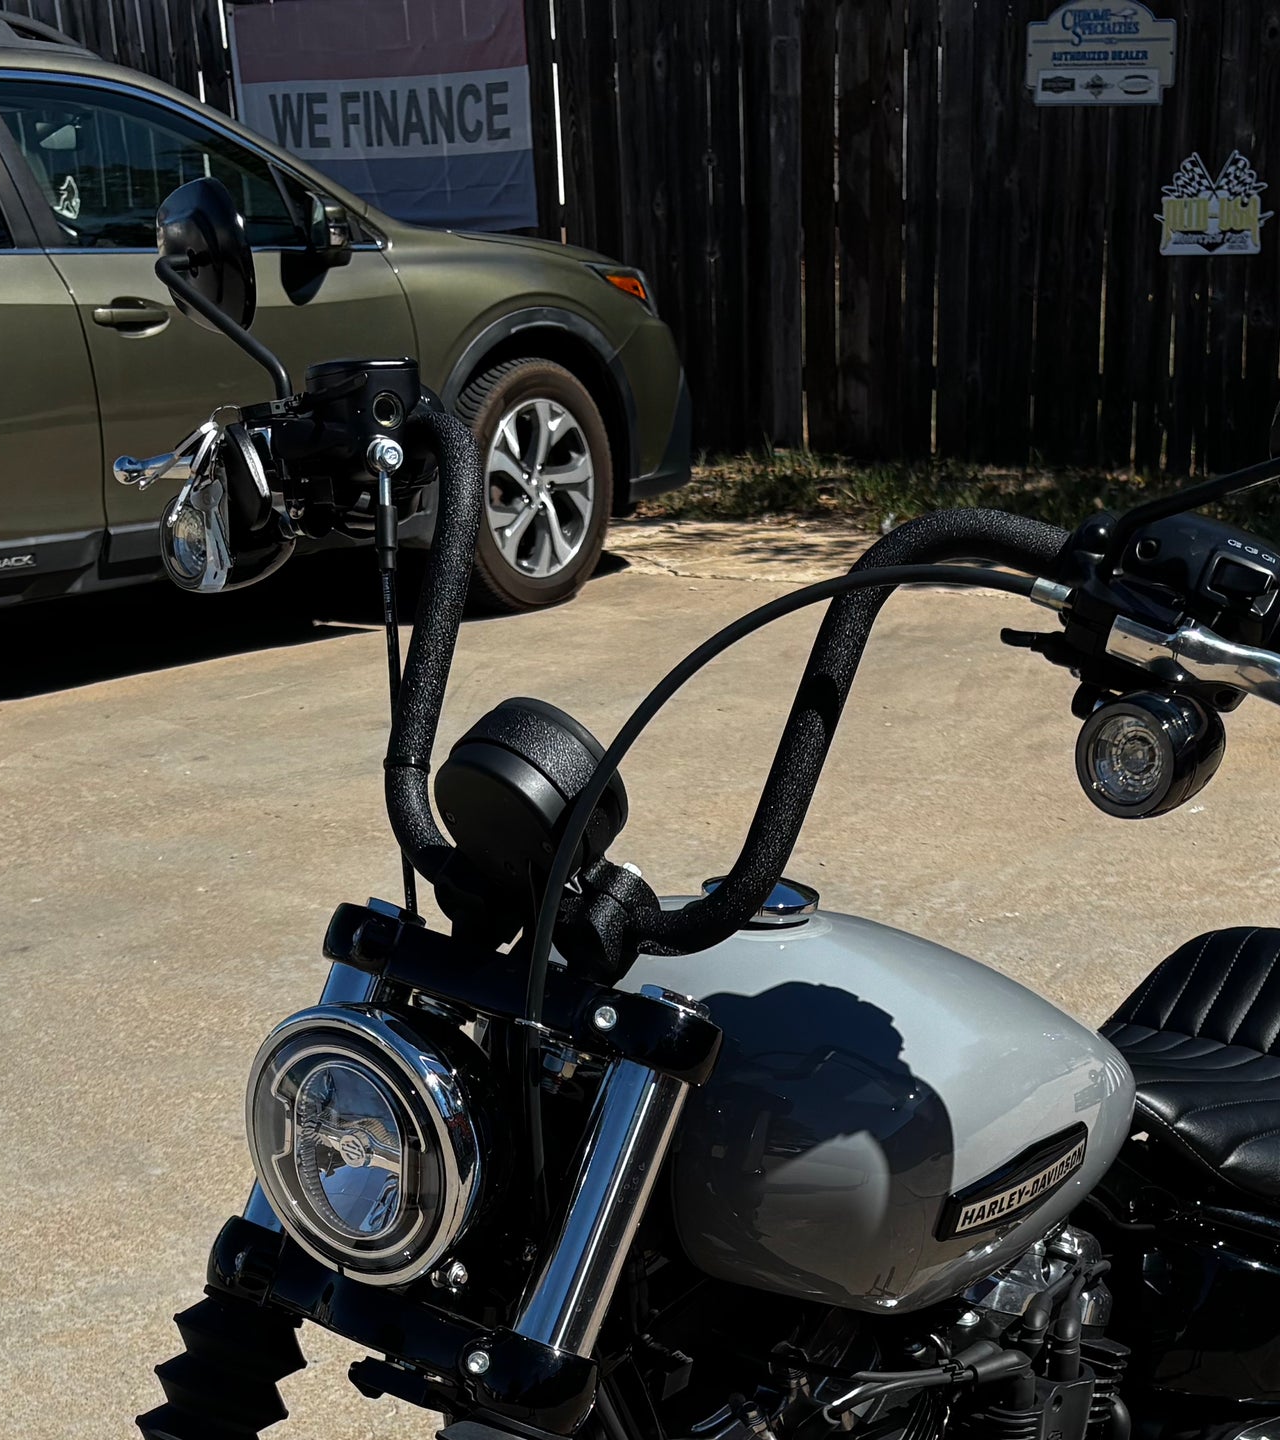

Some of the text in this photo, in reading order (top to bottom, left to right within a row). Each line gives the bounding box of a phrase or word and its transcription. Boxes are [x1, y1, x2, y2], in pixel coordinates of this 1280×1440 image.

[1052, 50, 1148, 61] AUTHORIZED DEALER
[269, 81, 511, 149] WE FINANCE
[960, 1142, 1085, 1227] HARLEY-DAVIDSON
